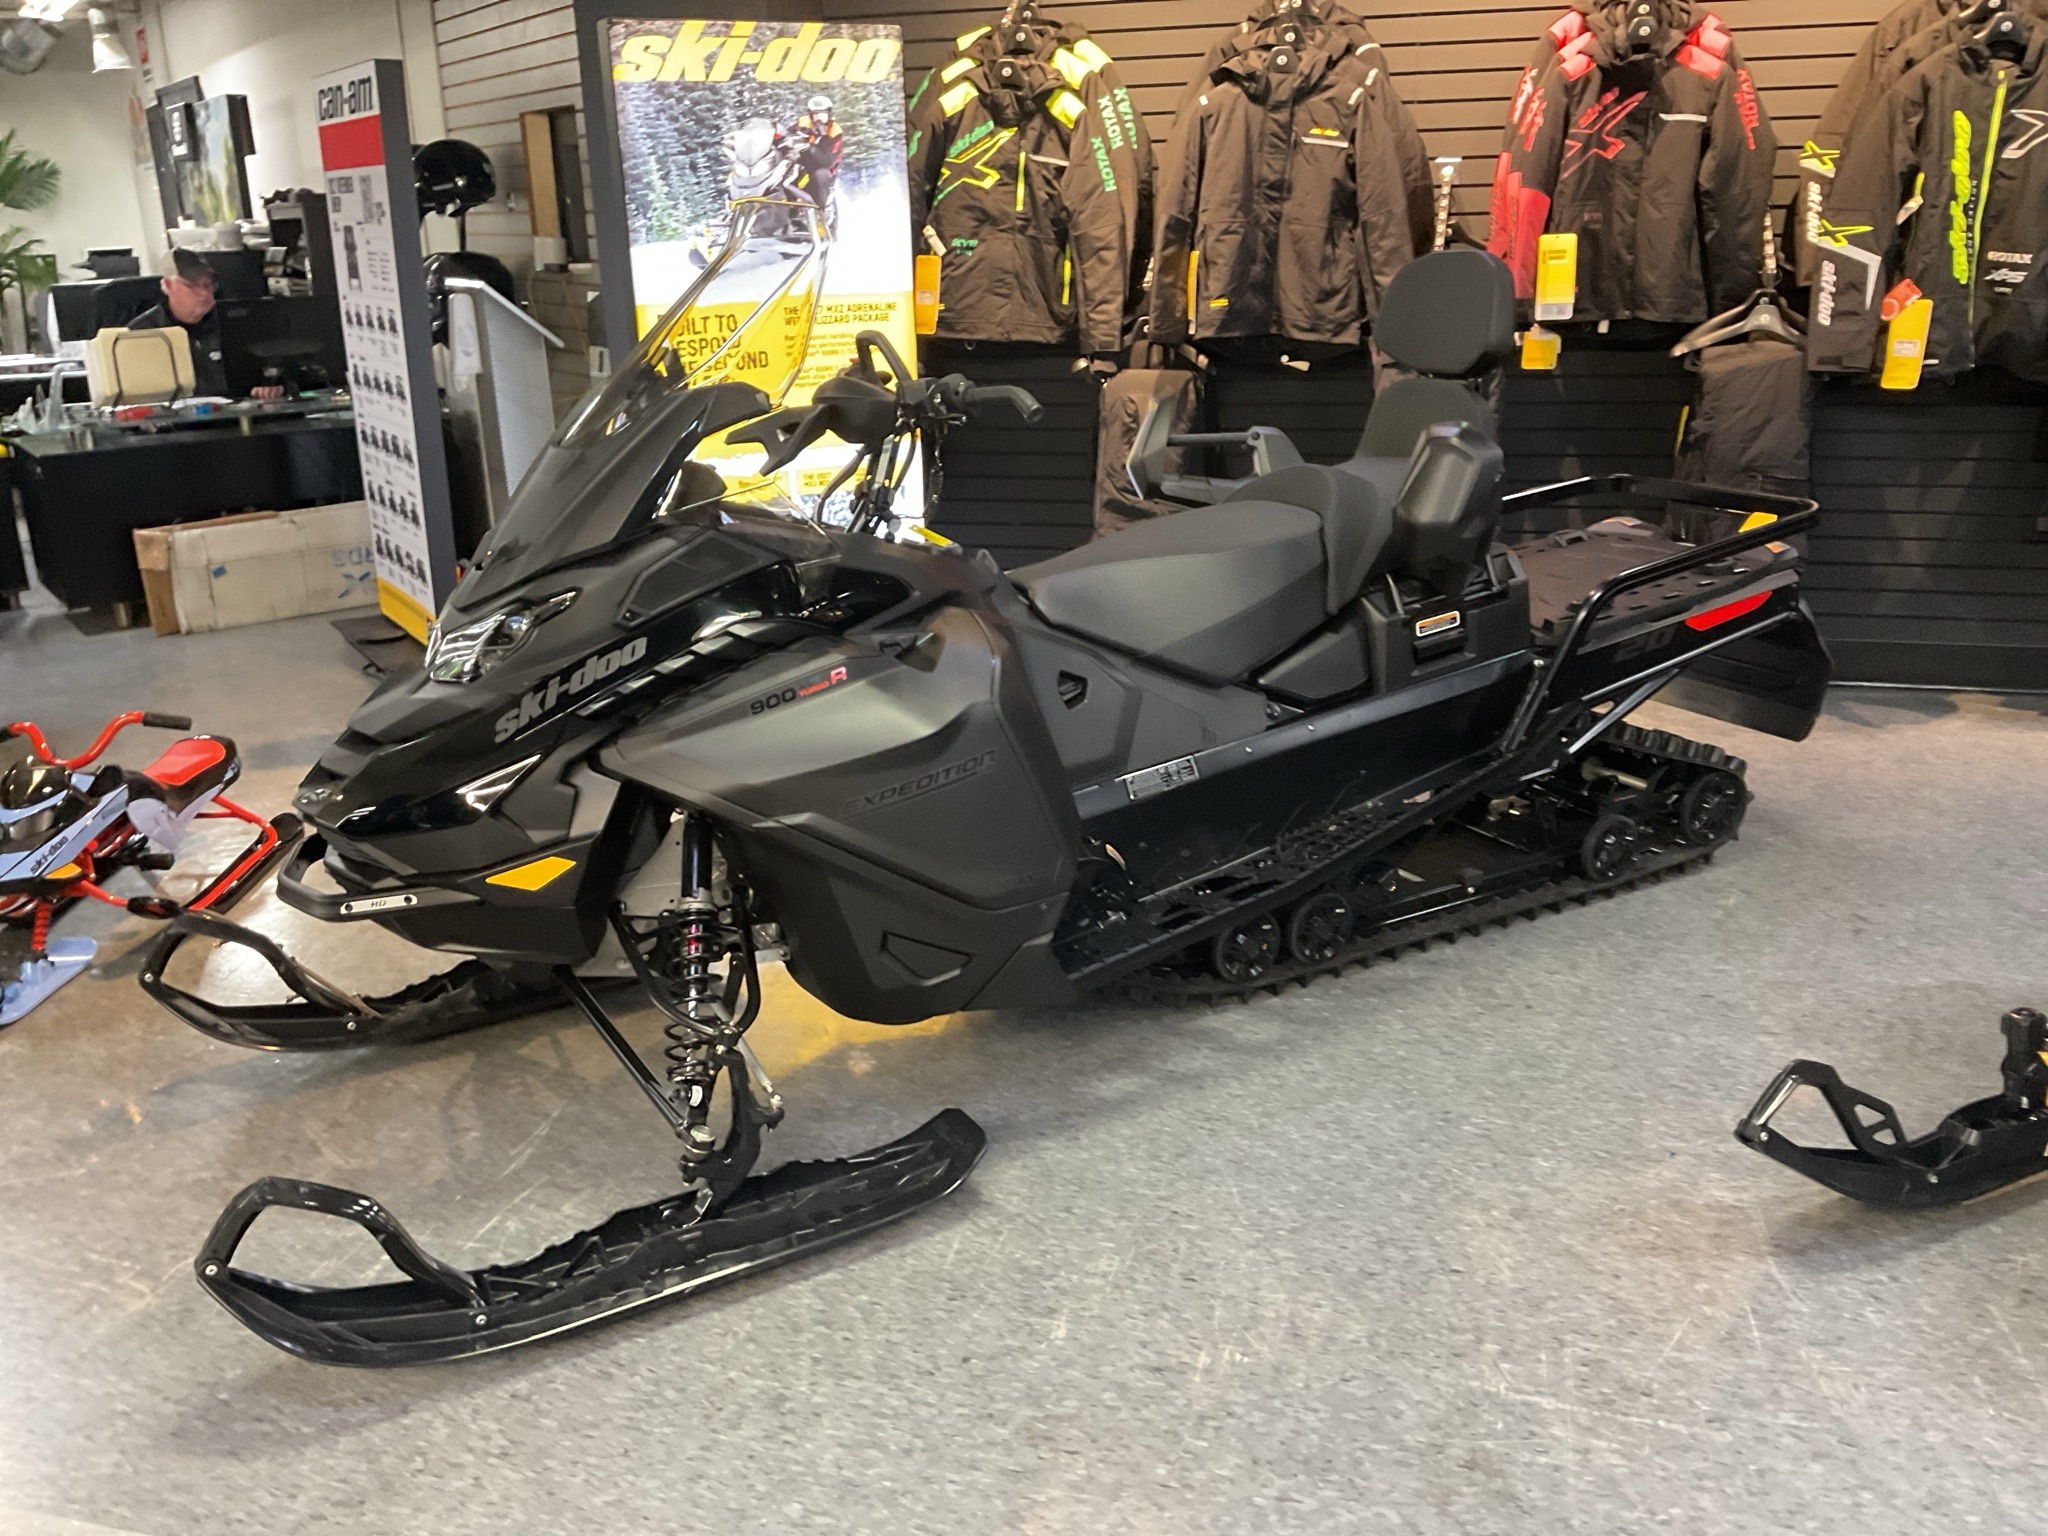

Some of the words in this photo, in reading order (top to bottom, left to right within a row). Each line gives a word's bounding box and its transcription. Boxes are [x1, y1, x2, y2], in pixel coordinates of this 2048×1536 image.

[612, 19, 901, 83] ski-doo
[318, 75, 373, 120] can-am
[1097, 95, 1125, 149] ROTAX
[1090, 136, 1118, 192] ROTAX
[1807, 181, 1823, 244] ski-doo
[847, 302, 897, 311] ADRENALINE
[853, 313, 890, 322] PACKAGE
[1817, 260, 1837, 326] ski-doo
[714, 313, 738, 333] TO
[495, 637, 647, 743] ski-doo
[750, 688, 797, 715] 900
[830, 666, 847, 685] R
[845, 750, 997, 808] EXPEDITION
[30, 835, 69, 875] ski-doo
[370, 899, 387, 908] HD
